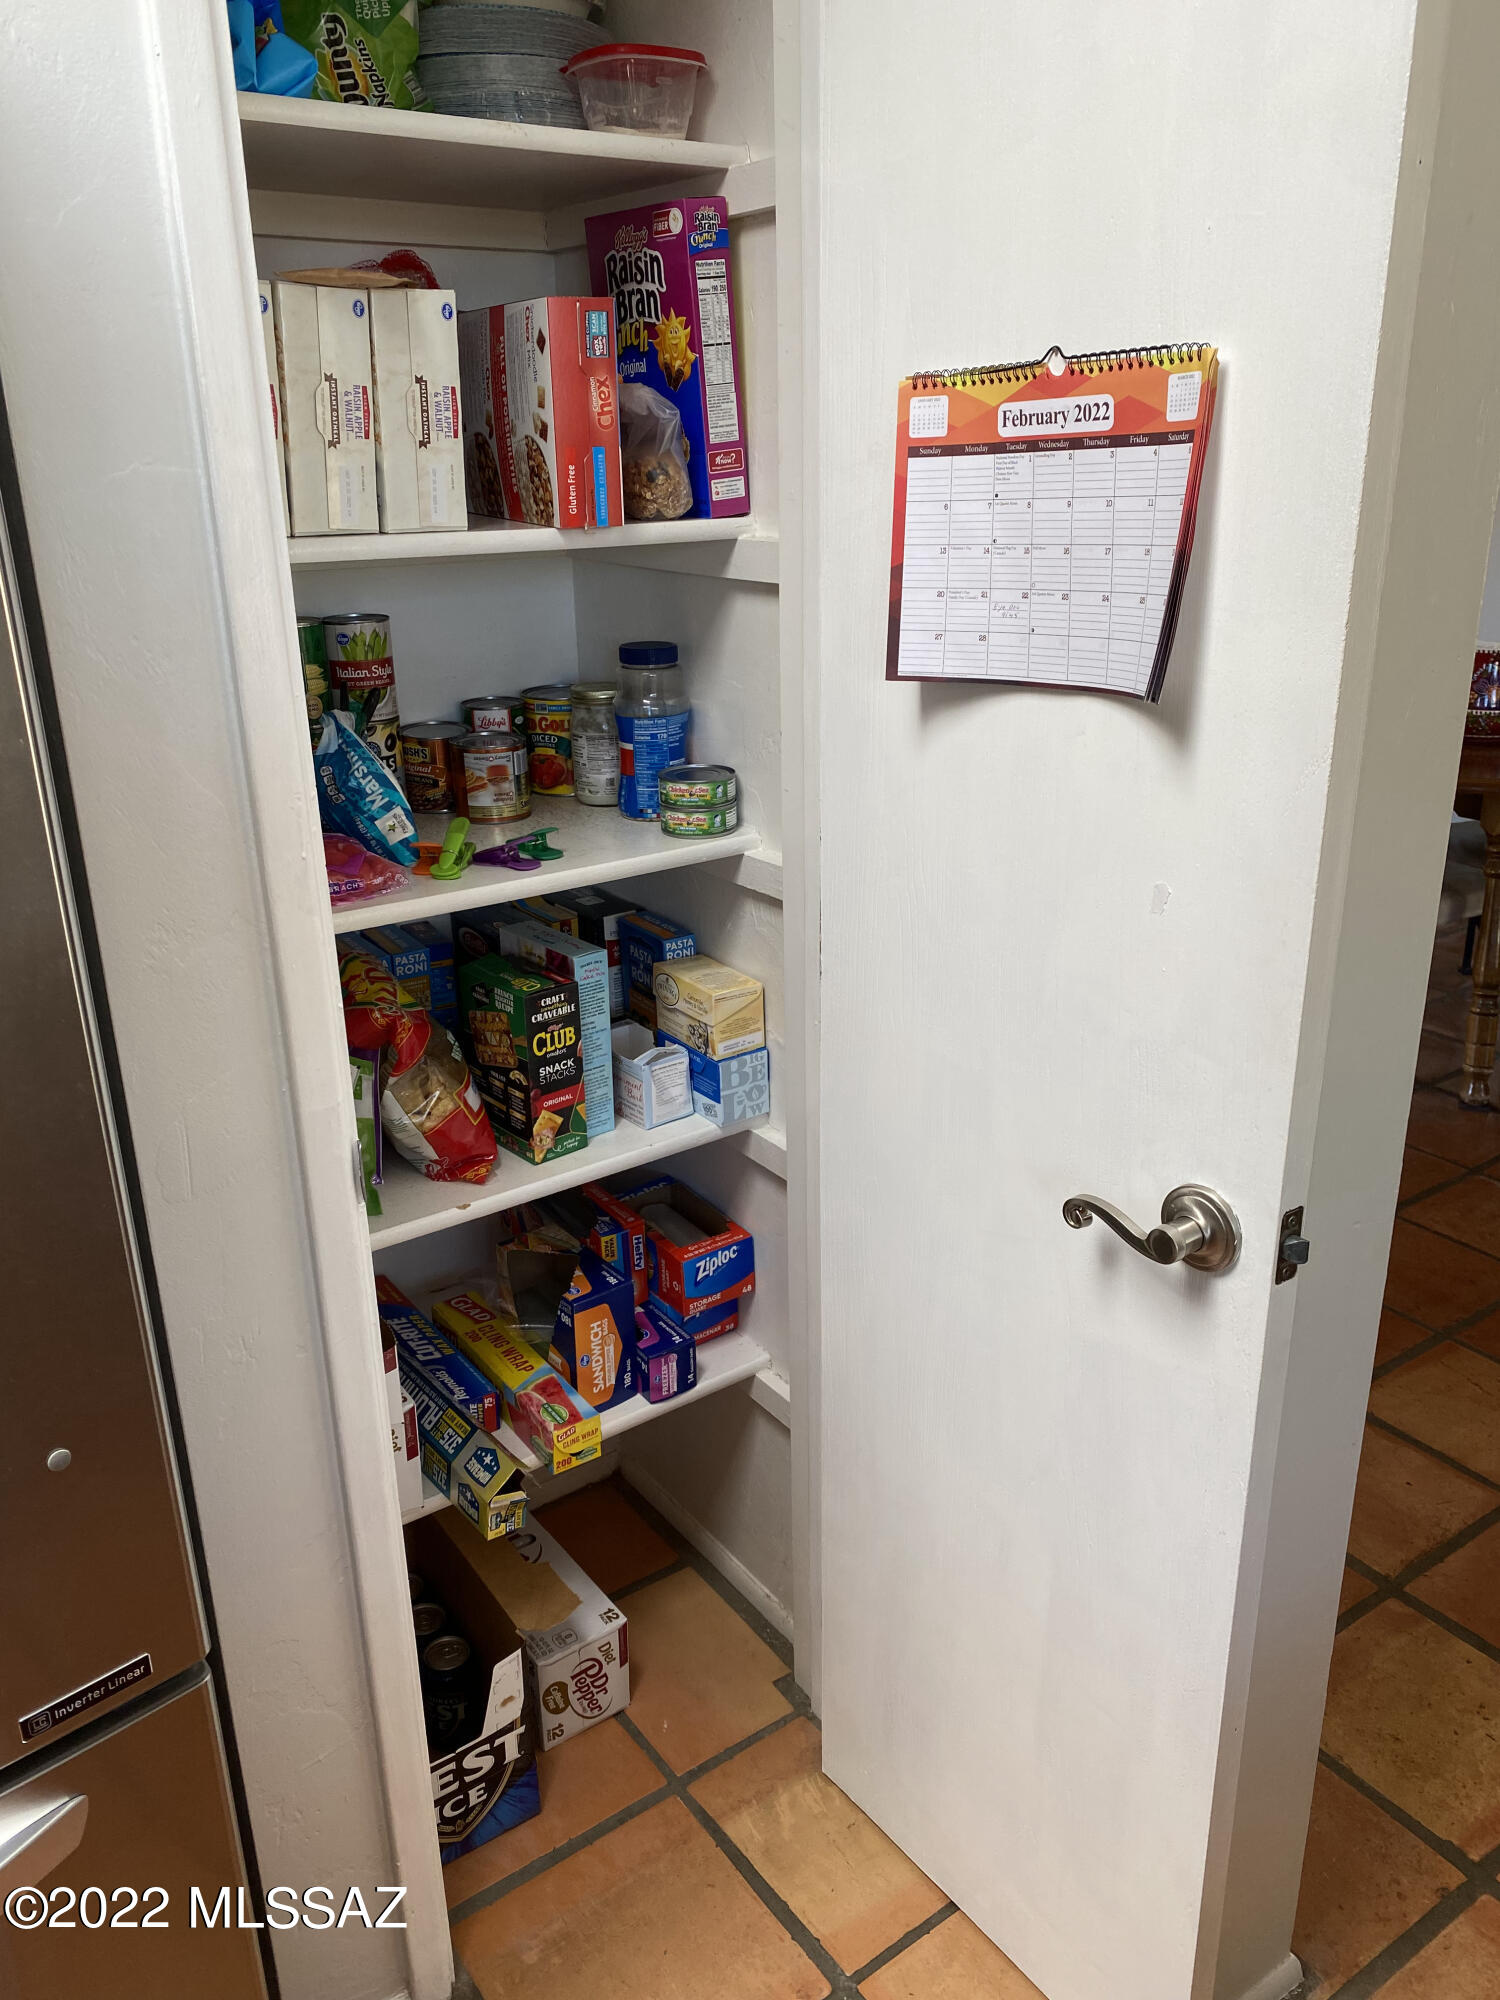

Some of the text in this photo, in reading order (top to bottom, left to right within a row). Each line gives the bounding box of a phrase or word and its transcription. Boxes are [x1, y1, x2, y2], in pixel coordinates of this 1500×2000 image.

[321, 12, 370, 105] ounty
[353, 38, 395, 107] Napkins
[693, 212, 720, 224] Raisin
[697, 220, 718, 232] Bran
[614, 225, 649, 251] Kellogg's
[690, 232, 716, 246] Crunch
[606, 249, 665, 292] Raisin
[616, 287, 662, 325] Bran
[619, 358, 647, 380] Original
[330, 380, 338, 410] INSTANT
[420, 382, 428, 410] INSTANT
[590, 376, 599, 412] Cinnamon
[594, 374, 616, 433] Chex
[344, 400, 354, 432] WALNUT
[434, 400, 444, 432] WALNUT
[1002, 402, 1110, 428] February 2022
[354, 416, 363, 440] APPLE
[444, 416, 452, 439] APPLE
[1082, 438, 1110, 446] Thursday
[1130, 434, 1149, 444] Friday
[1167, 432, 1190, 442] Saturday
[919, 446, 942, 455] Sunday
[964, 445, 988, 454] Monday
[1006, 442, 1028, 451] Tuesday
[1038, 440, 1070, 449] Wednesday
[1068, 452, 1072, 460] 2
[1154, 448, 1158, 457] 4
[568, 464, 578, 514] Gluten Free
[944, 503, 950, 511] 6
[988, 502, 992, 510] 7
[1066, 500, 1072, 508] 9
[1105, 500, 1113, 508] 10
[1148, 498, 1154, 506] 11
[940, 546, 947, 555] 13
[983, 546, 990, 555] 14
[1023, 546, 1030, 555] 15
[1064, 547, 1070, 555] 16
[1104, 548, 1112, 556] 17
[936, 590, 945, 598] 20
[980, 591, 988, 599] 21
[1021, 592, 1029, 600] 22
[1061, 592, 1070, 601] 23
[1102, 594, 1110, 603] 24
[934, 632, 944, 642] 27
[978, 634, 987, 643] 28
[336, 664, 392, 679] Italian Style
[478, 716, 506, 730] Libby's
[532, 734, 558, 744] DICED
[403, 746, 428, 759] USH'S
[668, 786, 690, 794] Chicken
[666, 814, 688, 822] Chicken
[666, 938, 694, 952] PASTA
[396, 952, 428, 965] PASTA
[630, 944, 652, 962] PASTA
[666, 947, 694, 960] RONI
[396, 963, 428, 976] RONI
[540, 992, 566, 1006] CRAFT
[531, 1003, 576, 1024] CRAVEABLE
[532, 1026, 576, 1056] CLUB
[539, 1058, 575, 1076] SNACK
[539, 1065, 576, 1086] STACKS
[543, 1094, 574, 1108] ORIGINAL
[634, 1236, 645, 1270] Hefty
[694, 1245, 738, 1282] Ziploc
[689, 1292, 721, 1310] STORAGE
[450, 1297, 492, 1322] GLAD
[389, 1316, 442, 1362] CUT-RITE
[408, 1314, 456, 1356] WAX PAPER
[464, 1328, 482, 1344] 200
[478, 1324, 535, 1374] CLING WRAP
[590, 1320, 604, 1394] SANDWICH
[434, 1368, 471, 1401] Reynolds
[624, 1372, 632, 1388] 180
[688, 1374, 694, 1384] 14
[484, 1397, 496, 1408] 75
[557, 1427, 576, 1442] GLAD
[562, 1428, 599, 1450] CLING WRAP
[556, 1457, 572, 1470] 200
[603, 1607, 620, 1624] 12
[598, 1642, 616, 1666] Diet
[570, 1658, 604, 1713] Pepper
[590, 1672, 609, 1696] Dr
[32, 1665, 145, 1732] LG Inverter Linear
[544, 1696, 556, 1710] Free
[550, 1722, 564, 1740] 12
